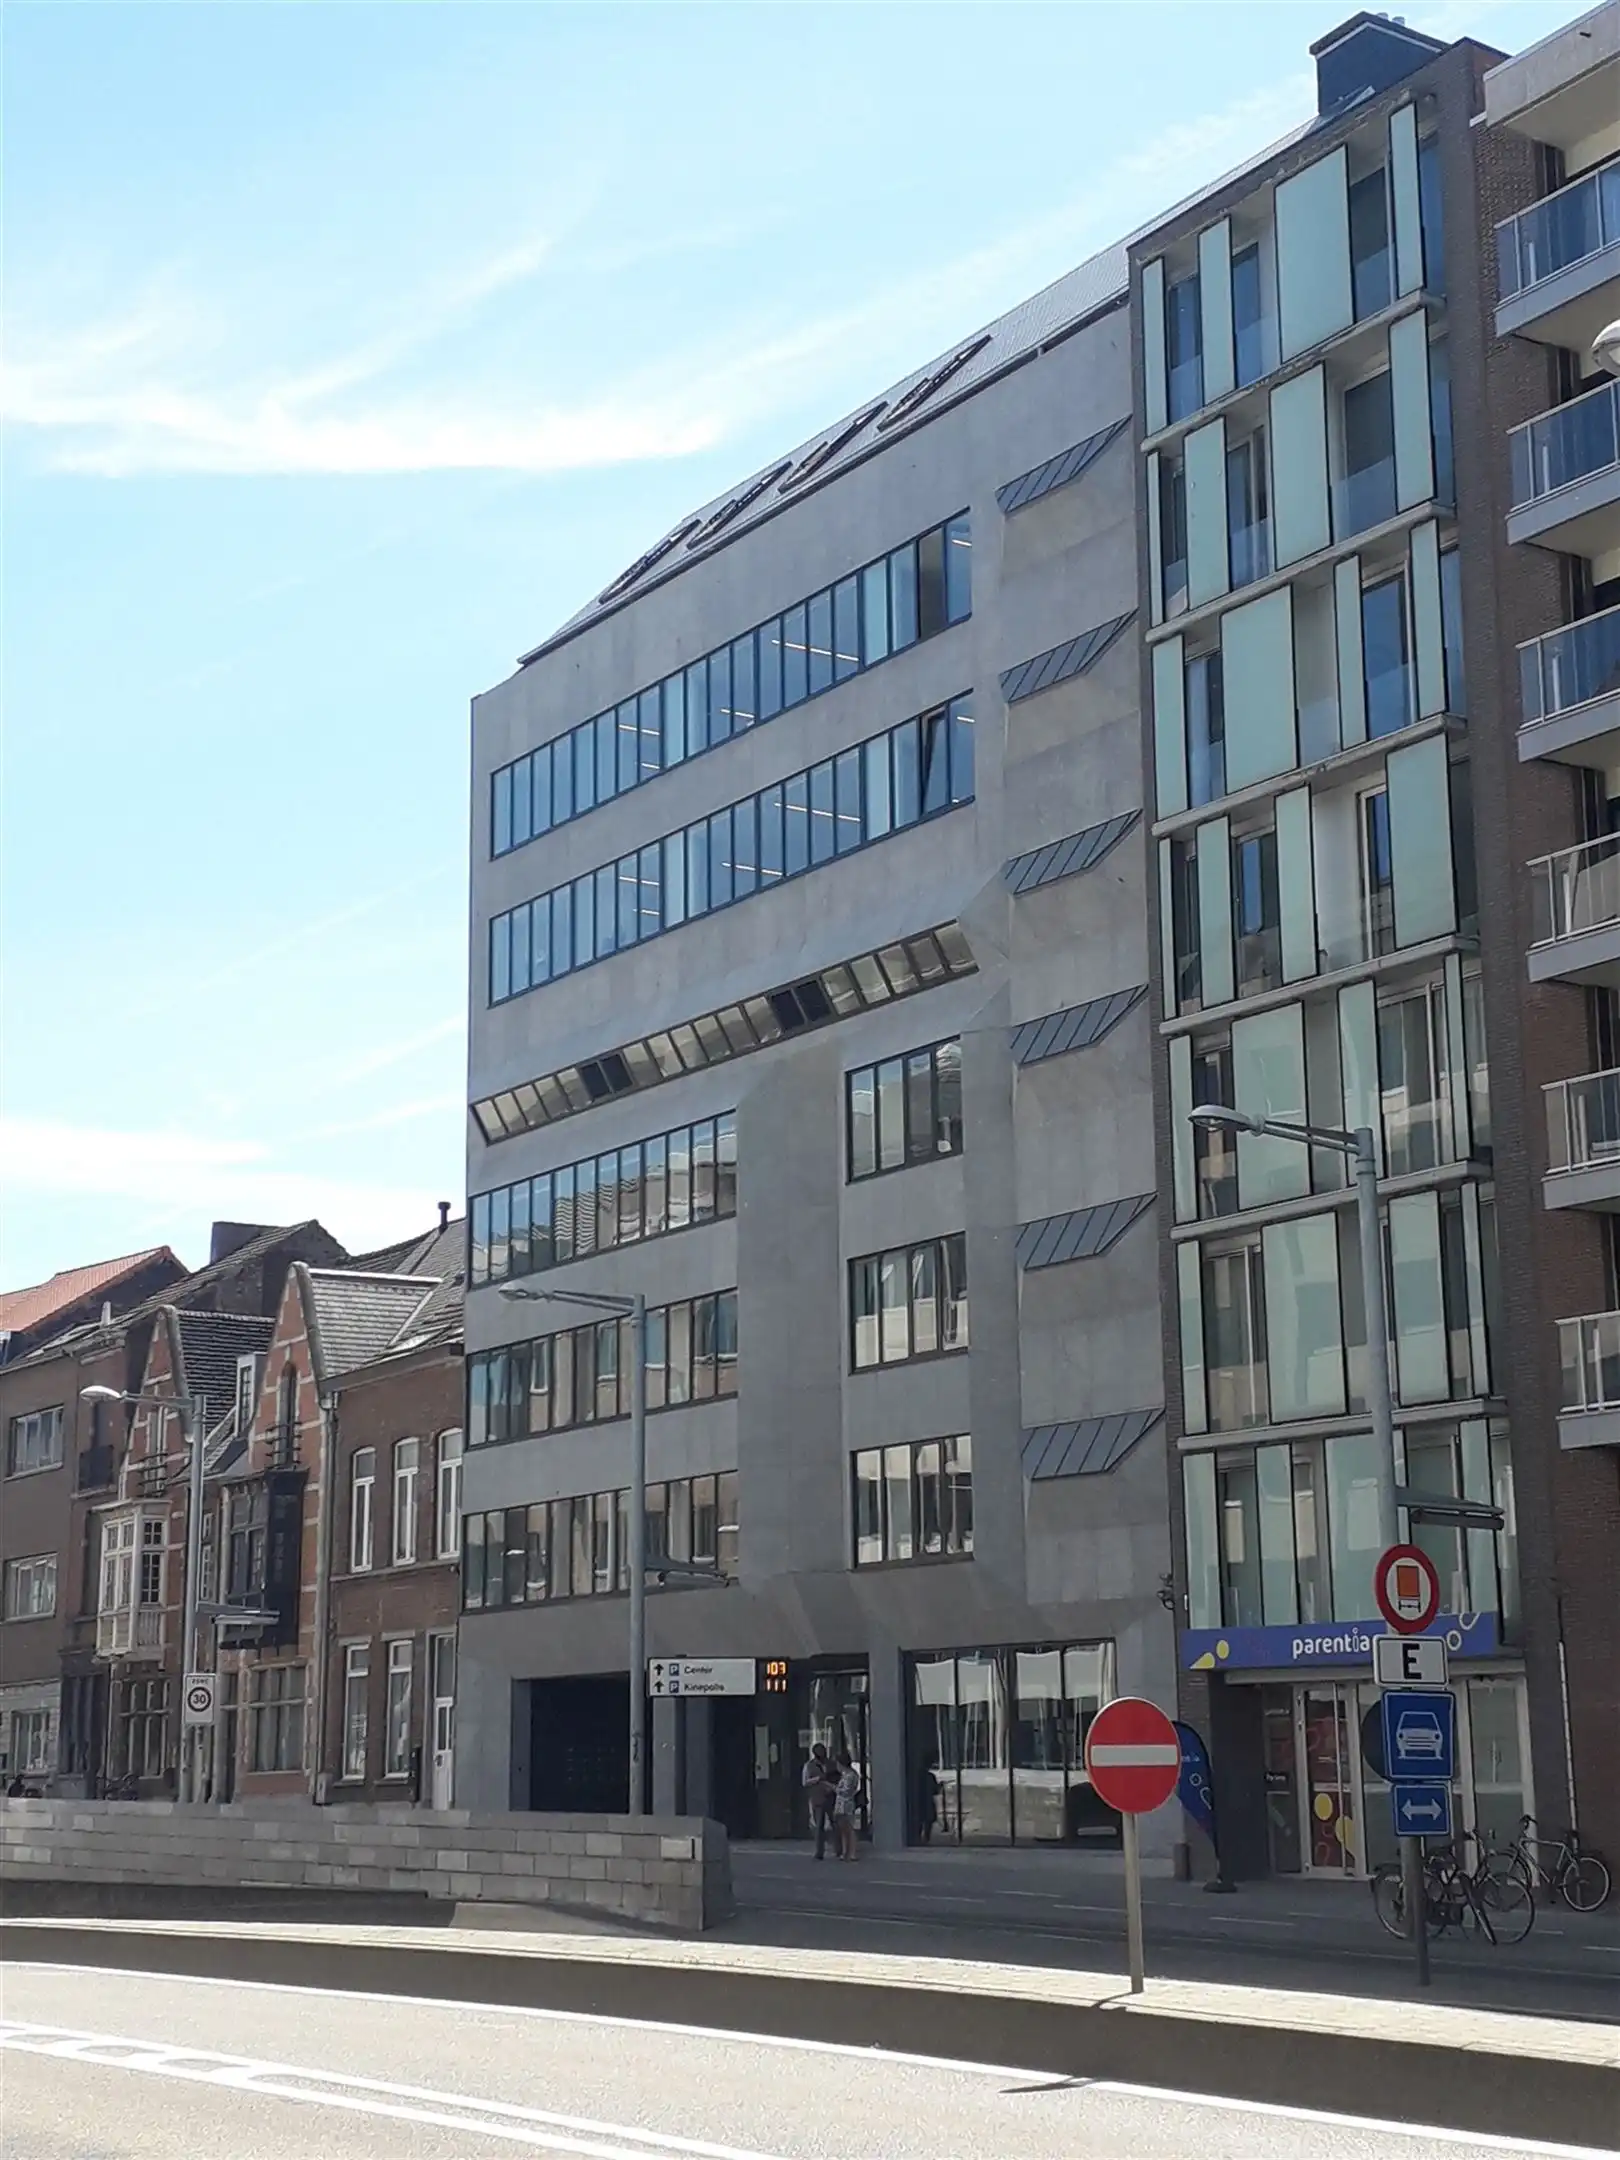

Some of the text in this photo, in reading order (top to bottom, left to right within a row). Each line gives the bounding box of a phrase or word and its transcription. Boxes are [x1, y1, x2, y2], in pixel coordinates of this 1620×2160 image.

[1293, 1627, 1370, 1660] parentia
[1402, 1643, 1422, 1679] E
[193, 1694, 206, 1704] 30
